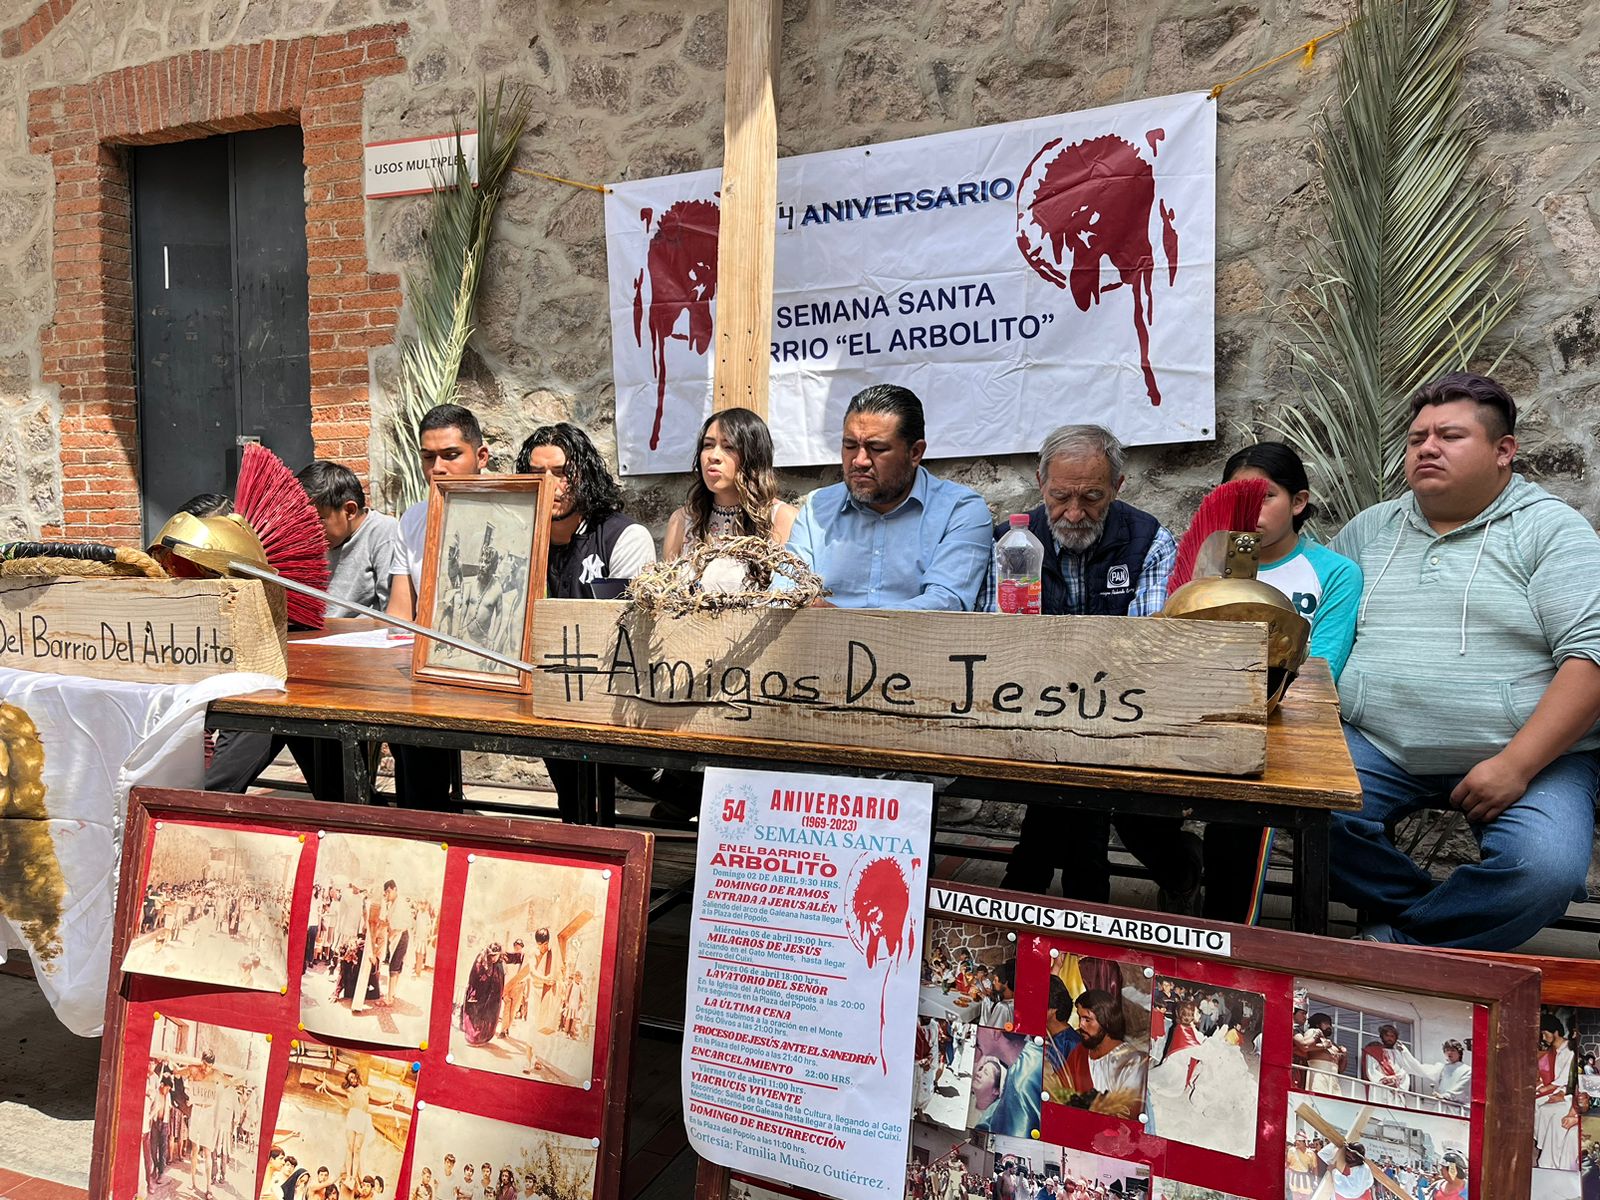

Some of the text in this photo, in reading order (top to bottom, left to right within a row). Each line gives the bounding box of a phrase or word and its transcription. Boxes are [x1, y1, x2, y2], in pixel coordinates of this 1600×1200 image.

[375, 162, 402, 174] USOS
[777, 178, 1014, 230] 4 ANIVERSARIO
[777, 282, 996, 328] SEMANA SANTA
[770, 338, 828, 362] RRIO
[1112, 572, 1128, 582] PAN
[32, 615, 97, 661] Barrio
[100, 622, 134, 663] Del
[143, 620, 234, 664] Arbolito
[544, 624, 1144, 724] #Amigos De Jesús
[722, 790, 899, 822] 54 ANIVERSARIO
[802, 816, 857, 832] (1969-2023)
[718, 844, 830, 862] EN EL BARRIO EL
[754, 825, 914, 855] SEMANA SANTA
[710, 853, 838, 878] ARBOLITO
[712, 868, 745, 880] Domingo
[758, 874, 770, 882] DE
[772, 875, 798, 884] ABRIL
[800, 878, 818, 886] 9:30
[820, 881, 841, 890] HRS.
[707, 890, 838, 914] ENTRADA A JERUSALÉN
[715, 879, 830, 900] DOMINGO DE RAMOS
[702, 900, 843, 924] Saliendo del arco de Galeana hasta llegar
[714, 909, 732, 918] Plaza
[732, 910, 742, 918] del
[937, 890, 1224, 950] VIACRUCIS DEL ARBOLITO
[707, 933, 822, 956] MILAGROS DE JESÚS
[714, 925, 748, 936] Miércoles
[762, 932, 770, 940] de
[772, 932, 792, 942] abril
[794, 936, 816, 946] 19:00
[818, 938, 834, 948] hrs.
[698, 940, 846, 969] Iniciando Gato Montes, hasta llegar
[705, 950, 722, 958] cerro
[706, 969, 828, 996] LAVATORIO DEL SEÑOR
[714, 962, 738, 972] Jueves
[750, 967, 759, 975] de
[760, 968, 780, 979] abril
[782, 972, 803, 982] 18:00
[806, 976, 821, 985] hrs.
[697, 986, 818, 1012] hrs seguimos Plaza Popolo.
[704, 997, 792, 1020] LA ÚLTIMA CENA
[716, 980, 738, 990] Iglesia
[826, 998, 838, 1006] las
[841, 1000, 865, 1010] 20:00
[716, 1017, 736, 1026] Olivos
[742, 1022, 752, 1030] las
[754, 1024, 773, 1034] 21:00
[775, 1028, 788, 1037] hrs.
[726, 1010, 843, 1038] subimos oración Monte
[693, 1024, 878, 1066] PROCESO DE JESÚS ANTE EL SANEDRÍN
[711, 1038, 818, 1067] Plaza del Popolo las 21:40 hrs.
[691, 1046, 853, 1086] ENCARCELAMIENTO 22:00 HRS.
[699, 1064, 726, 1076] Viernes
[748, 1073, 766, 1086] abril
[768, 1080, 788, 1090] 11:00
[790, 1083, 806, 1094] hrs.
[691, 1071, 802, 1105] VIACRUCIS VIVIENTE
[718, 1096, 742, 1108] retorno
[742, 1104, 754, 1112] por
[756, 1106, 784, 1118] Galeana
[784, 1112, 804, 1123] hasta
[806, 1116, 826, 1128] llegar
[842, 1126, 862, 1136] mina
[862, 1128, 876, 1138] del
[878, 1130, 902, 1142] Cuixi.
[726, 1090, 902, 1133] Salida de Casa de Cultura, llegando Gato
[690, 1103, 846, 1150] DOMINGO DE RESURRECCIÓN
[704, 1119, 807, 1155] Plaza del Popolo las 11:00 hrs.
[690, 1126, 884, 1190] Cortesía: Familia Muñoz Gutiérrez
